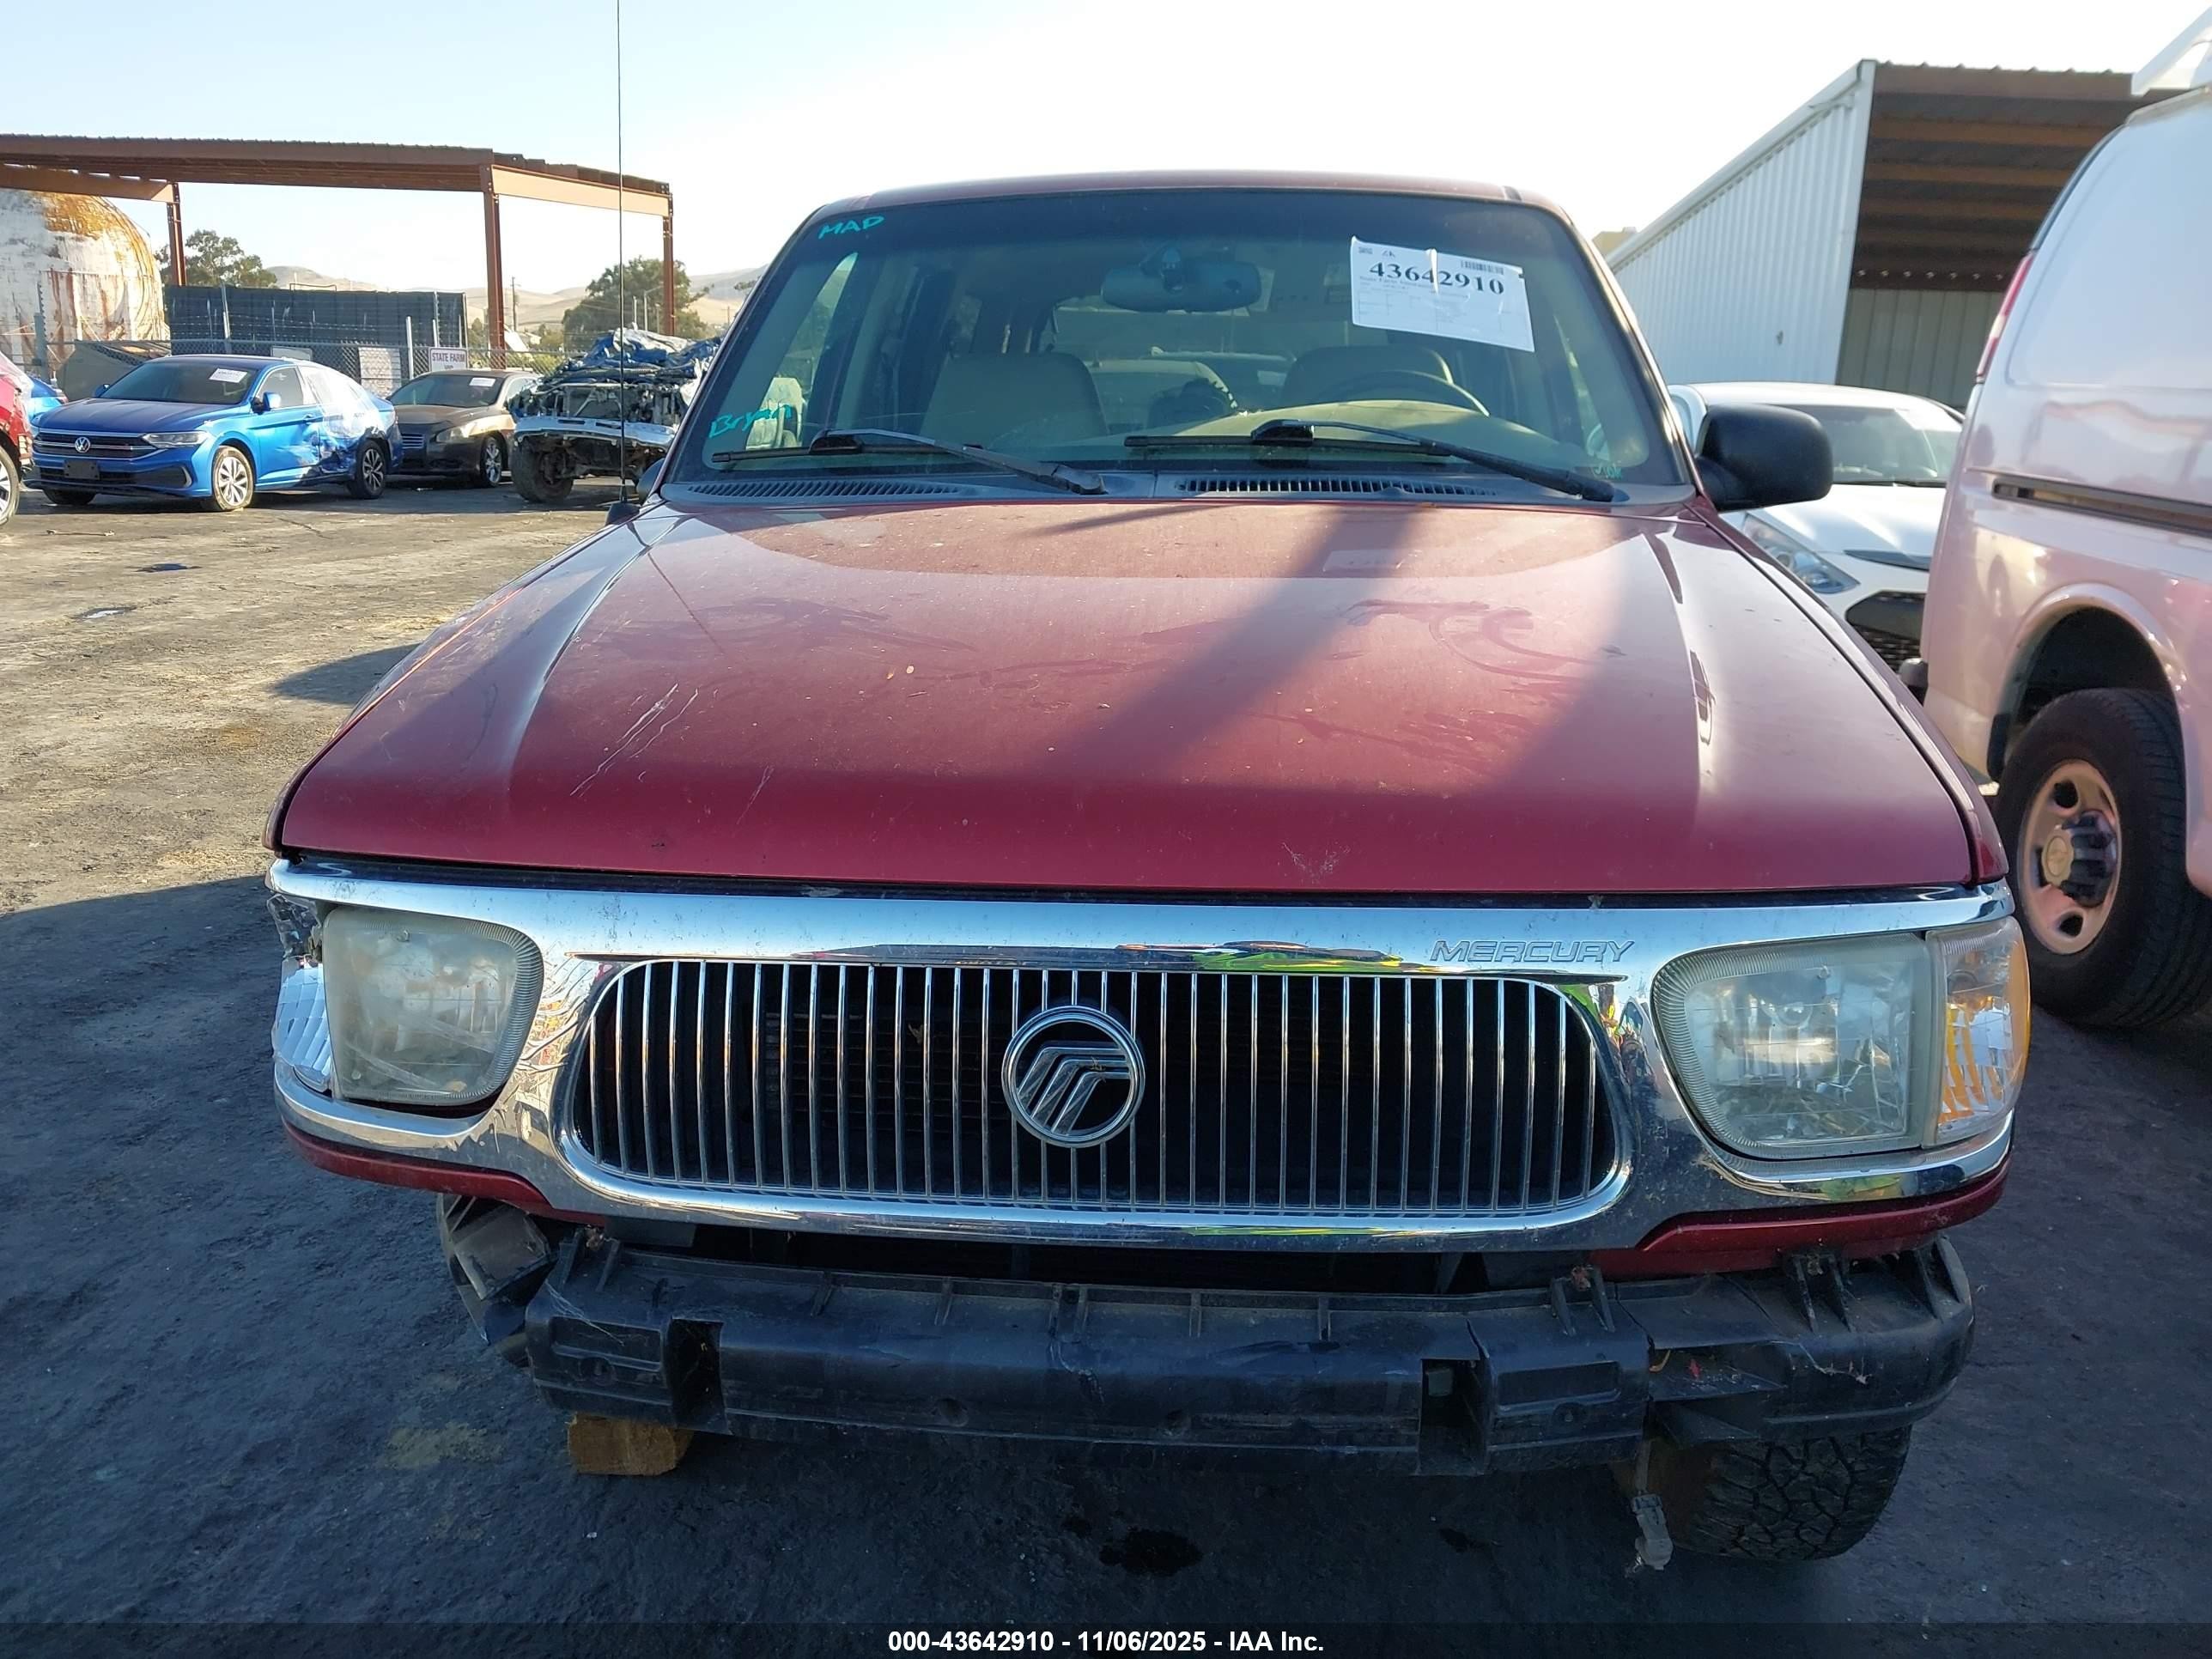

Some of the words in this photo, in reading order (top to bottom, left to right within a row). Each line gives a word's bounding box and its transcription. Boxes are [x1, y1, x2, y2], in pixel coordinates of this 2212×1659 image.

[1369, 261, 1504, 295] 43642910
[432, 352, 449, 362] STATE
[449, 353, 465, 362] FARM
[1430, 940, 1635, 963] MERCURY
